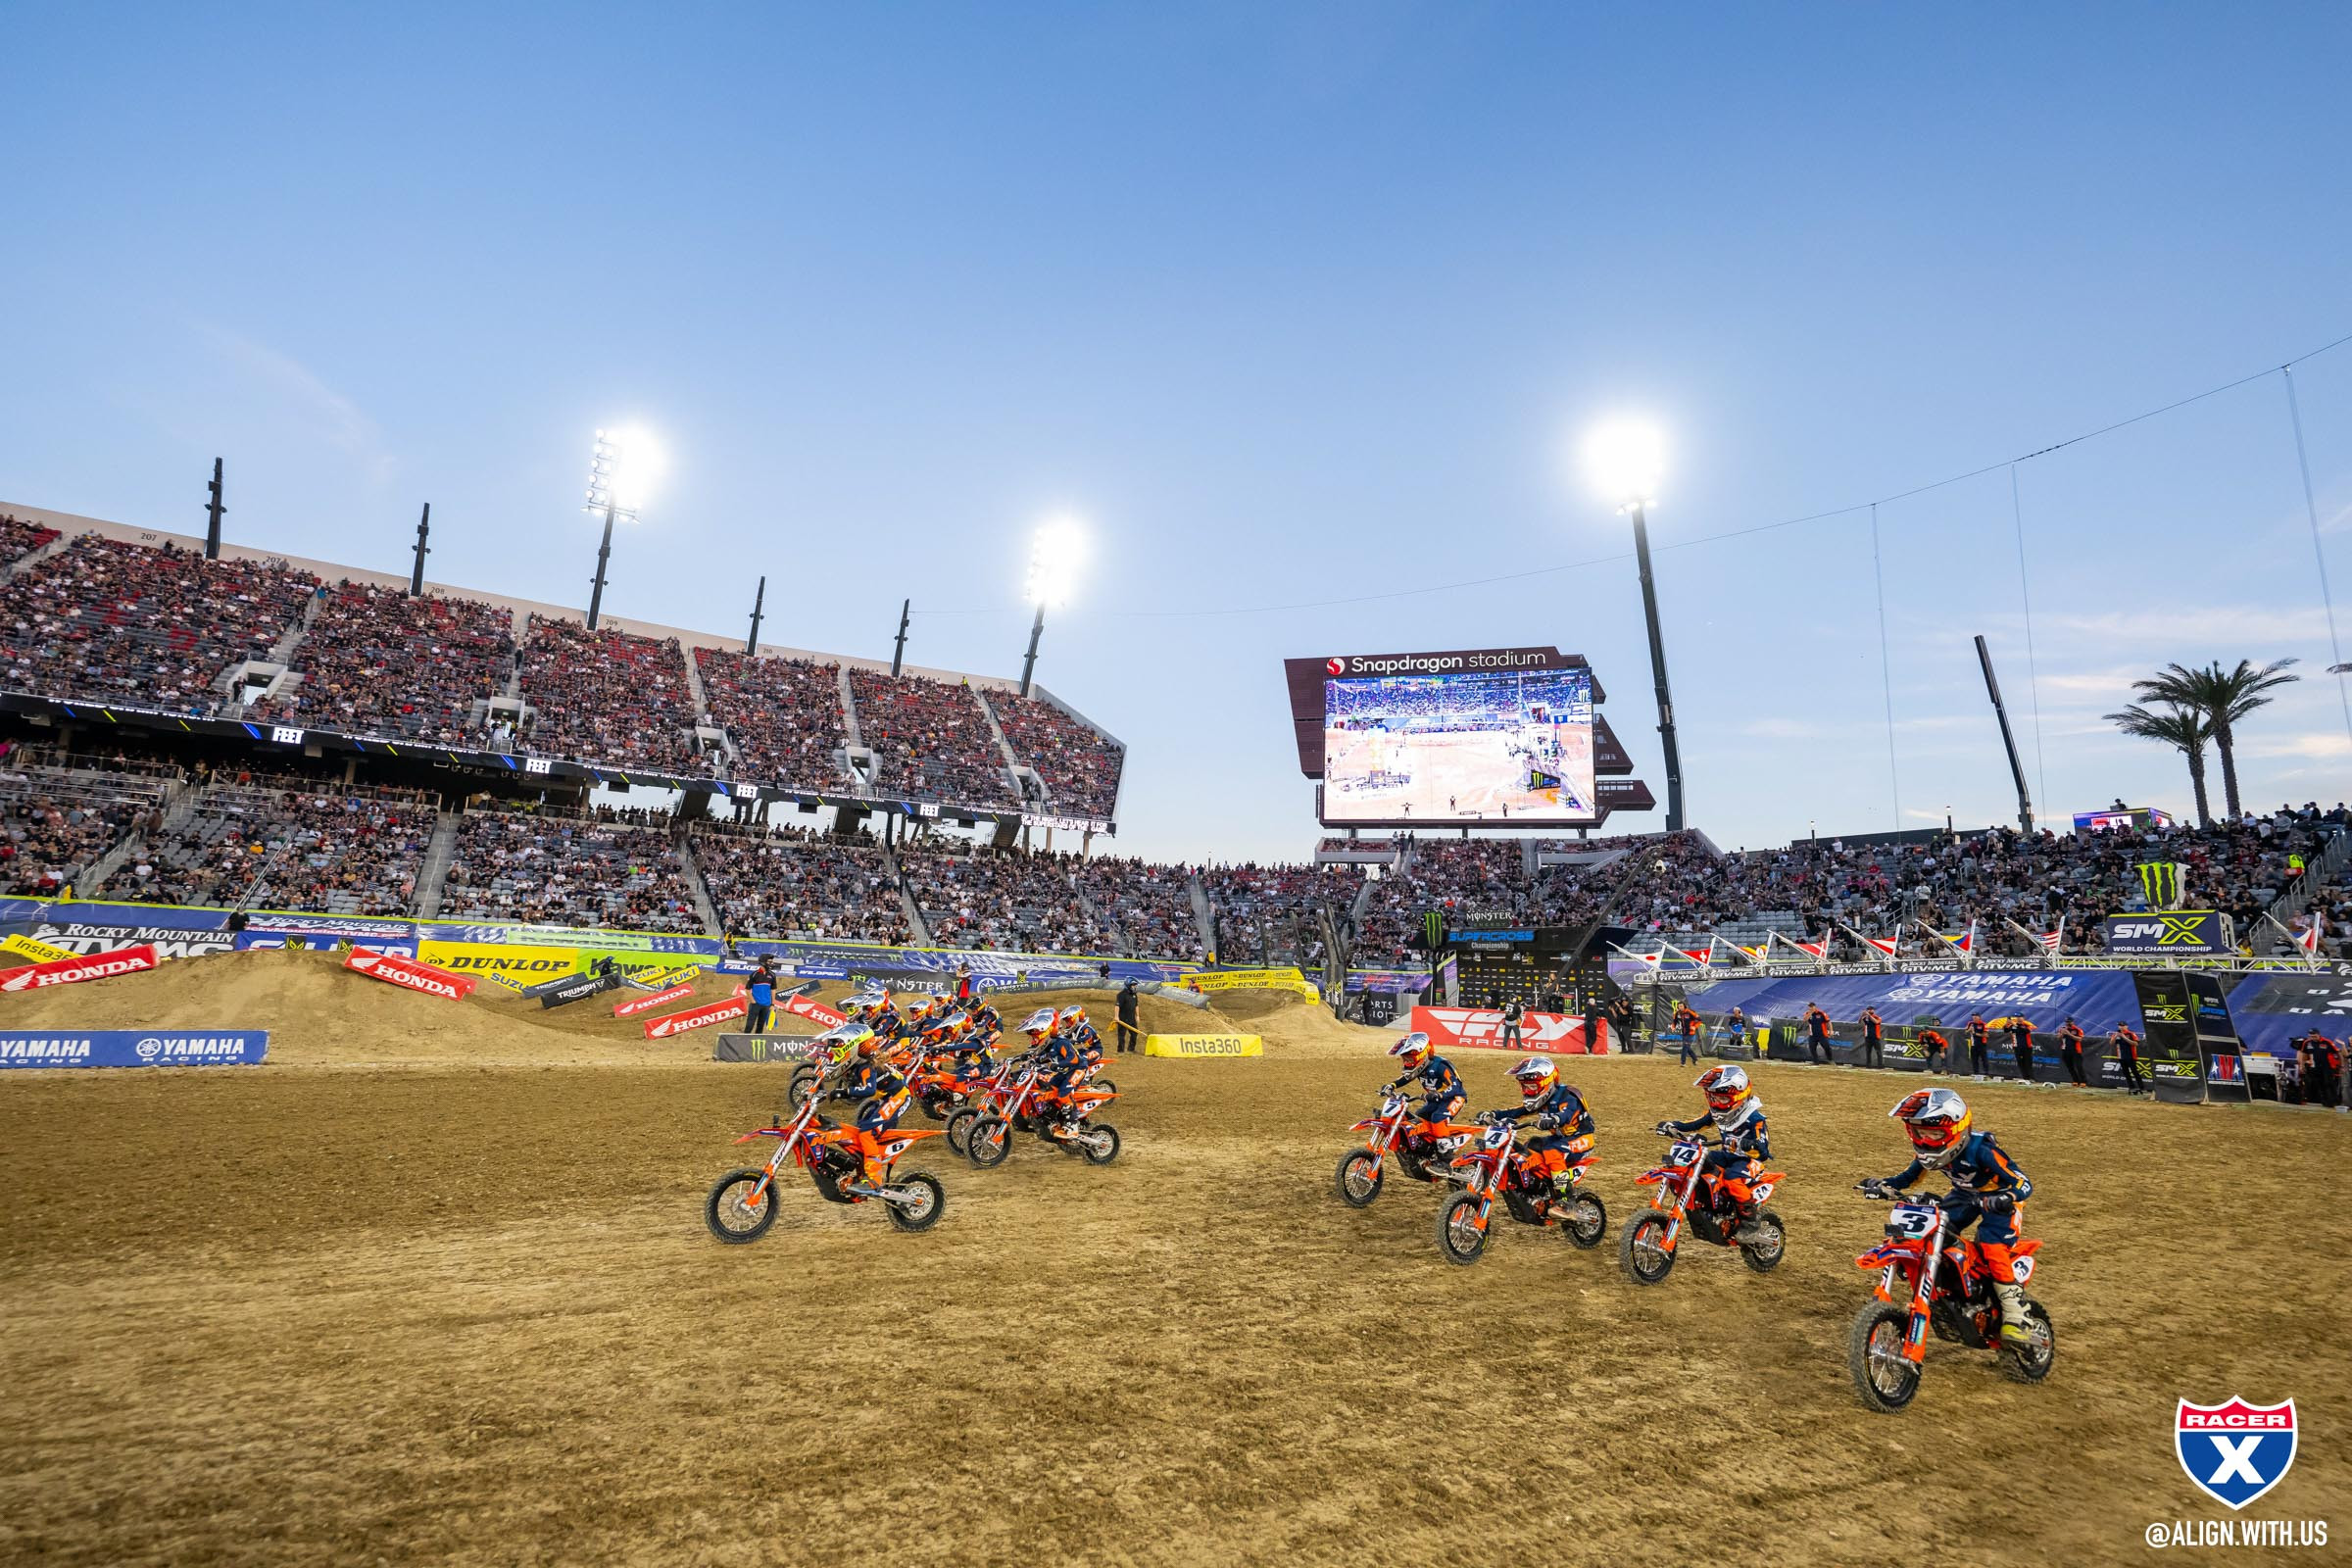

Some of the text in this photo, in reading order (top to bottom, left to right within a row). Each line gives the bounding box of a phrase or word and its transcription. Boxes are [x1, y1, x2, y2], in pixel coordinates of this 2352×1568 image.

[141, 532, 157, 541] 207
[266, 556, 281, 564] 207
[1351, 651, 1545, 674] Snapdragon stadium
[526, 759, 552, 773] FEET
[737, 785, 758, 798] FEET
[920, 805, 939, 816] FEET
[1466, 911, 1513, 921] MONSTER
[323, 919, 410, 929] MOUNTAIN
[2112, 917, 2206, 945] SMX
[65, 923, 237, 942] ROCKY MOUNTAIN
[1448, 931, 1535, 941] SUPERCROSS
[448, 956, 570, 972] DUNLOP
[36, 957, 151, 987] HONDA
[628, 967, 662, 981] UZUKI
[374, 964, 457, 998] HONDA
[491, 972, 530, 991] SUZU
[886, 978, 944, 992] NSTER
[1945, 974, 2073, 987] YAMAHA
[557, 983, 597, 999] TRIUMPH
[1925, 990, 2054, 1003] YAMAHA
[637, 988, 691, 1009] HONDA
[672, 1006, 745, 1033] HONDA
[809, 1009, 847, 1028] HON
[2145, 1007, 2186, 1020] SMX
[0, 1040, 91, 1057] YAMAHA
[163, 1038, 244, 1055] YAMAHA
[843, 1037, 861, 1054] 100%
[1180, 1038, 1242, 1054] Insta360
[1459, 1037, 1549, 1051] RACING
[1883, 1043, 1925, 1058] SMX
[2155, 1062, 2197, 1077] SMX
[1420, 1077, 1439, 1087] FLY
[1385, 1102, 1398, 1114] 7
[1951, 1108, 1973, 1135] 100
[1458, 1135, 1465, 1145] 7
[1486, 1132, 1503, 1146] 4
[892, 1143, 905, 1152] 6
[1670, 1147, 1696, 1164] 14
[1572, 1167, 1582, 1178] 4
[1897, 1212, 1929, 1234] 3
